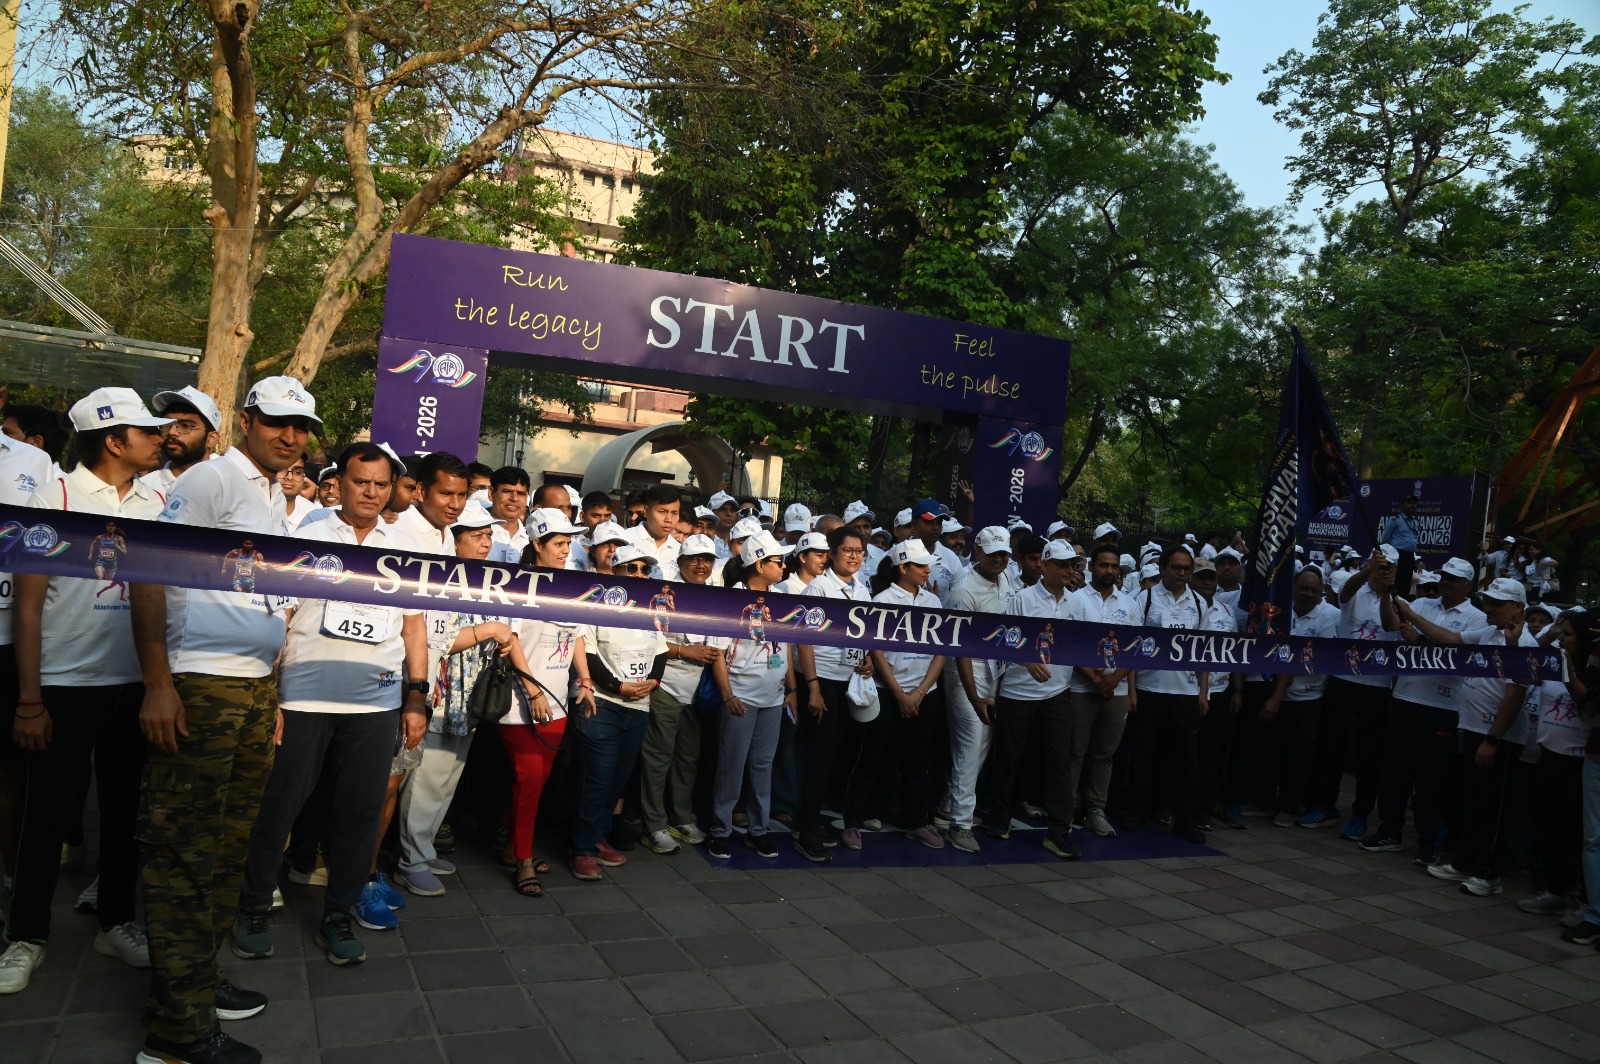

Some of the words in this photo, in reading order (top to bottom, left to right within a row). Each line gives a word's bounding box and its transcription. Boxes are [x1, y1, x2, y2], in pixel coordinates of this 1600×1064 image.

[502, 265, 569, 291] Run
[455, 297, 498, 326] the
[508, 303, 603, 350] legacy
[646, 295, 865, 374] START
[953, 333, 996, 357] Feel
[920, 364, 954, 388] the
[961, 374, 1020, 400] pulse
[416, 396, 438, 437] 2026
[950, 464, 960, 499] 2026
[1009, 468, 1025, 504] 2026
[1436, 530, 1452, 546] 26
[1438, 515, 1452, 530] 20
[373, 554, 555, 608] START
[338, 619, 374, 639] 452
[434, 619, 445, 634] 15
[846, 605, 973, 647] START
[1169, 634, 1257, 665] START
[1395, 645, 1458, 670] START
